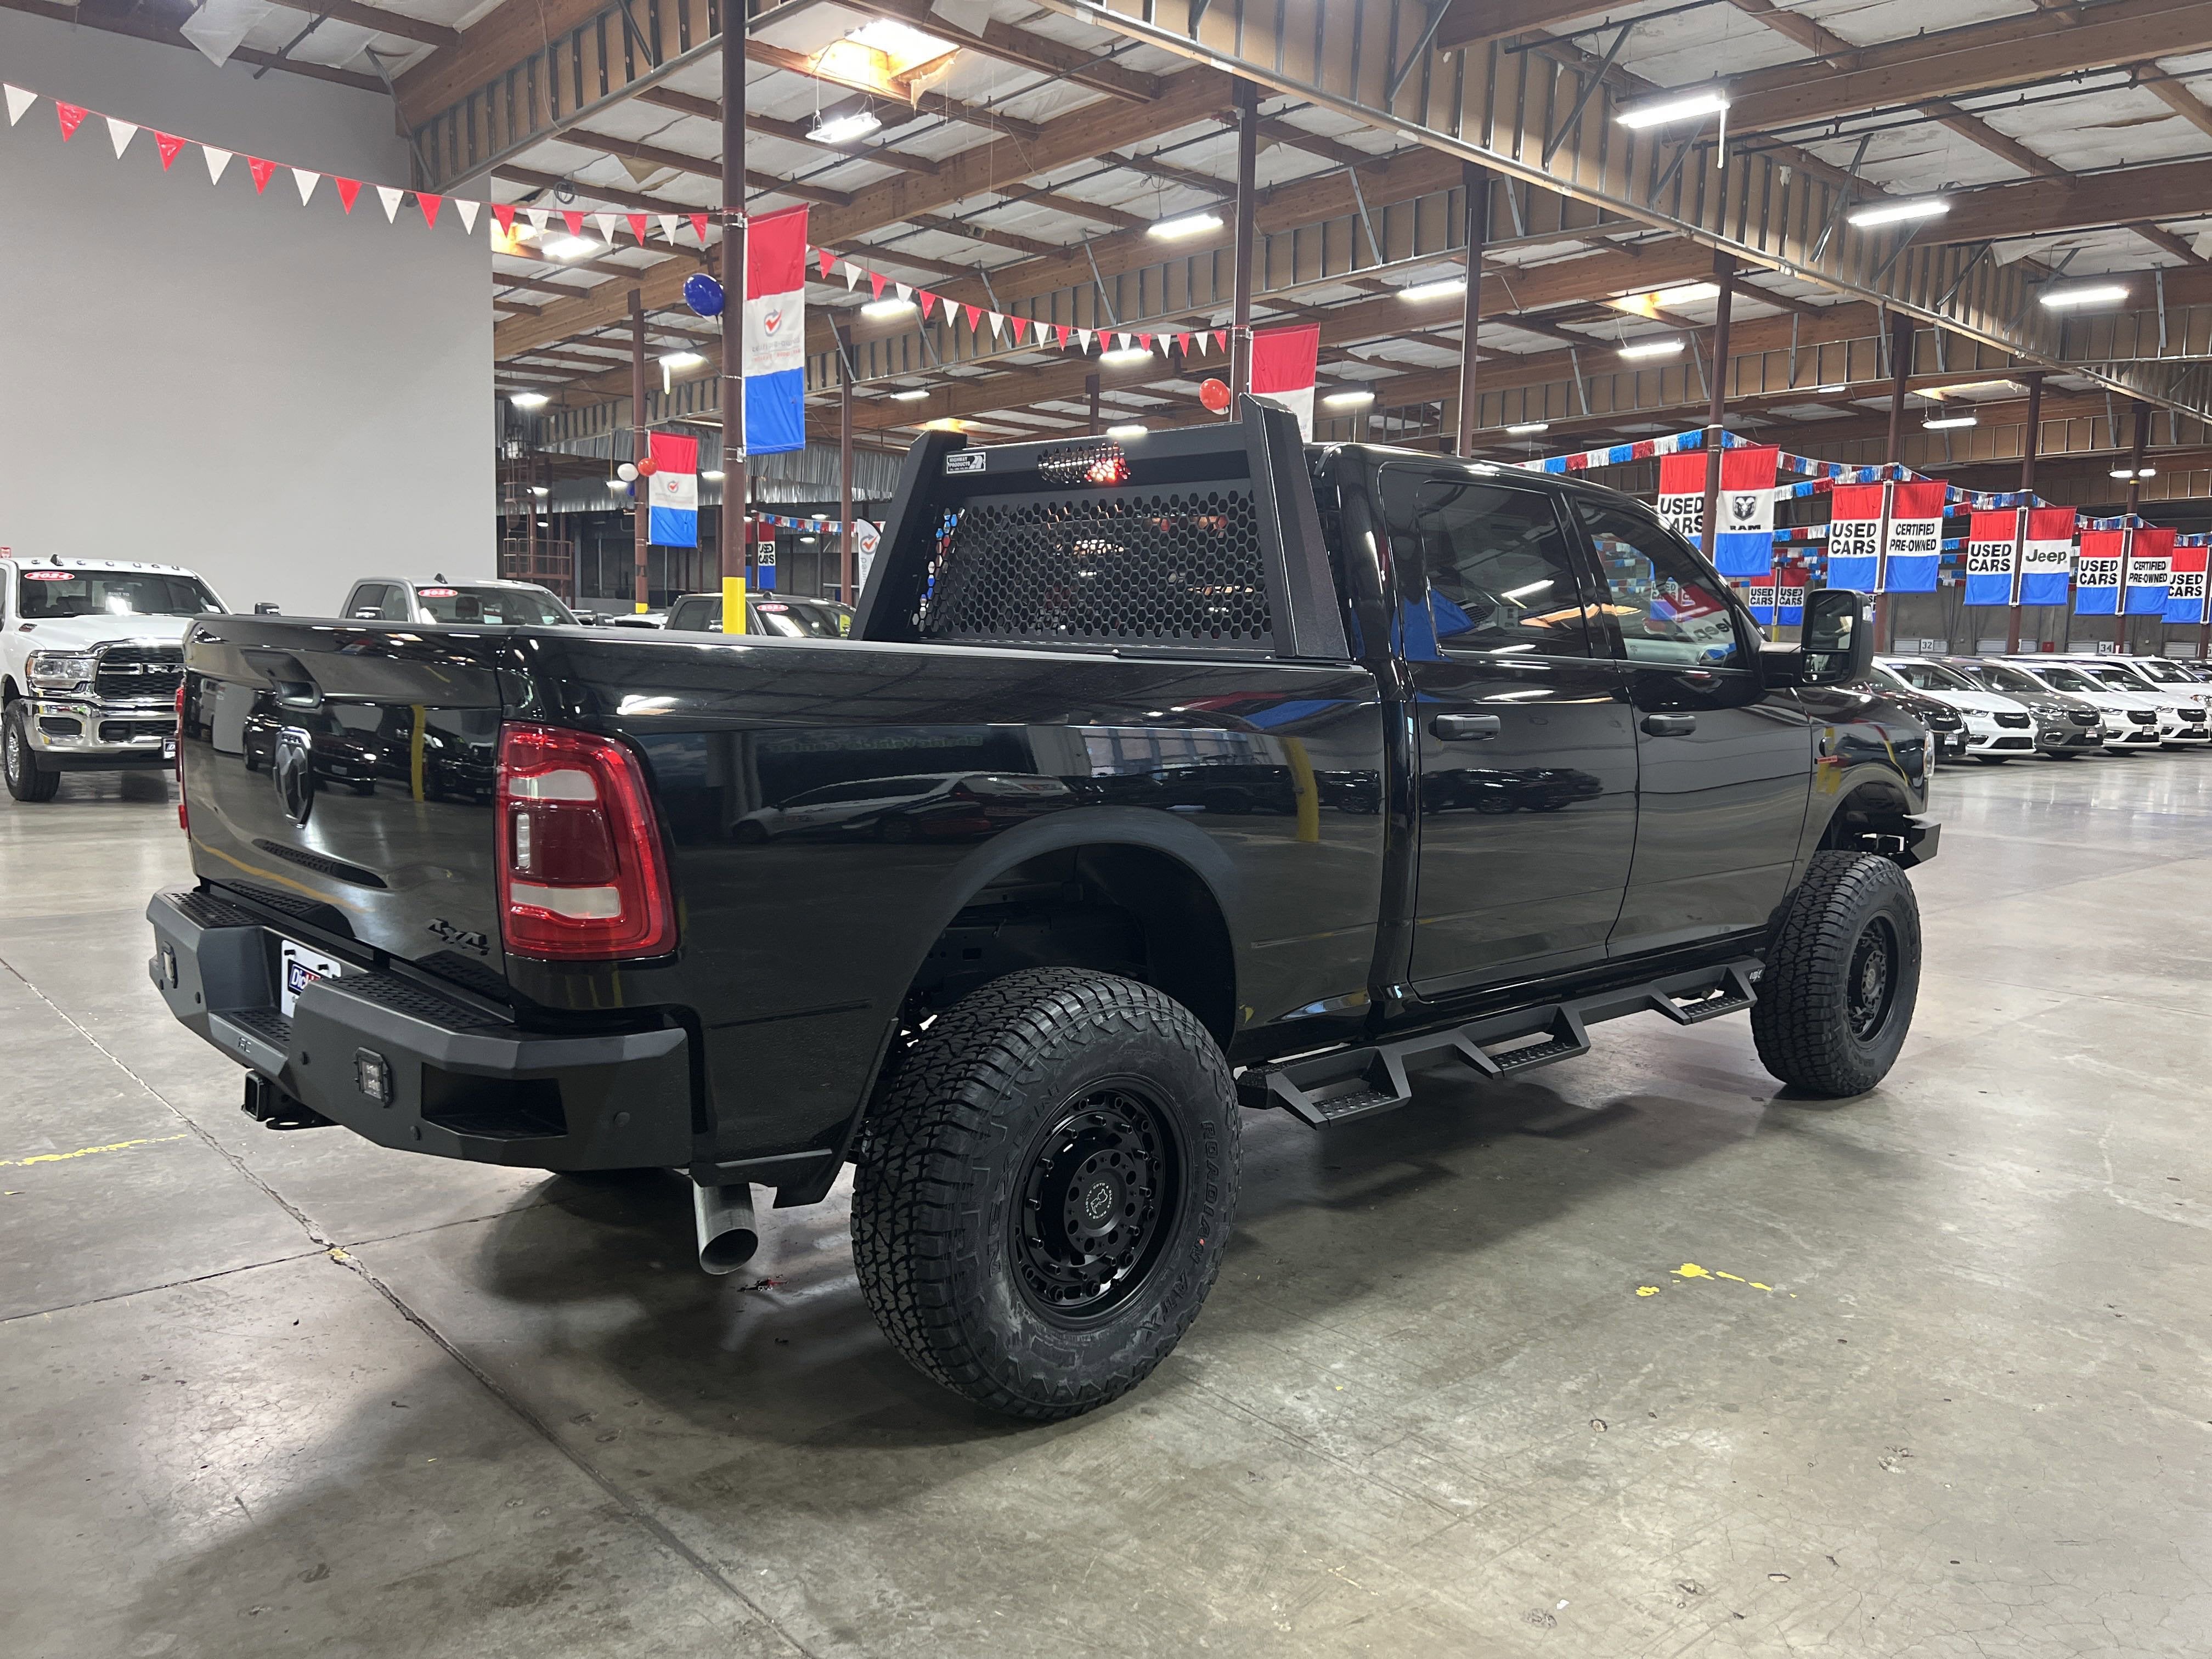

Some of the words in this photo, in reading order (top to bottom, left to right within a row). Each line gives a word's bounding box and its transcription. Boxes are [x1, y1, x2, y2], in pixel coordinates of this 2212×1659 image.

[1660, 496, 1704, 515] USED
[1664, 515, 1703, 534] ARS
[1832, 523, 1876, 538] USED
[1895, 523, 1935, 535] CERTIFIED
[1831, 539, 1876, 555] CARS
[1889, 539, 1937, 552] PRE-OWNED
[1970, 544, 2012, 557] USED
[2025, 549, 2067, 564] Jeep
[1968, 558, 2011, 572] CARS
[2080, 560, 2118, 572] USED
[2134, 561, 2166, 571] CERTIFIED
[2079, 573, 2118, 585] CARS
[2129, 573, 2168, 583] PRE-OWNED
[2169, 574, 2204, 585] USED
[1751, 588, 1774, 596] USED
[1780, 588, 1803, 596] USED
[2168, 586, 2203, 597] CARS
[1779, 597, 1802, 605] CARS
[1922, 641, 1932, 650] 32
[2100, 644, 2112, 652] 34
